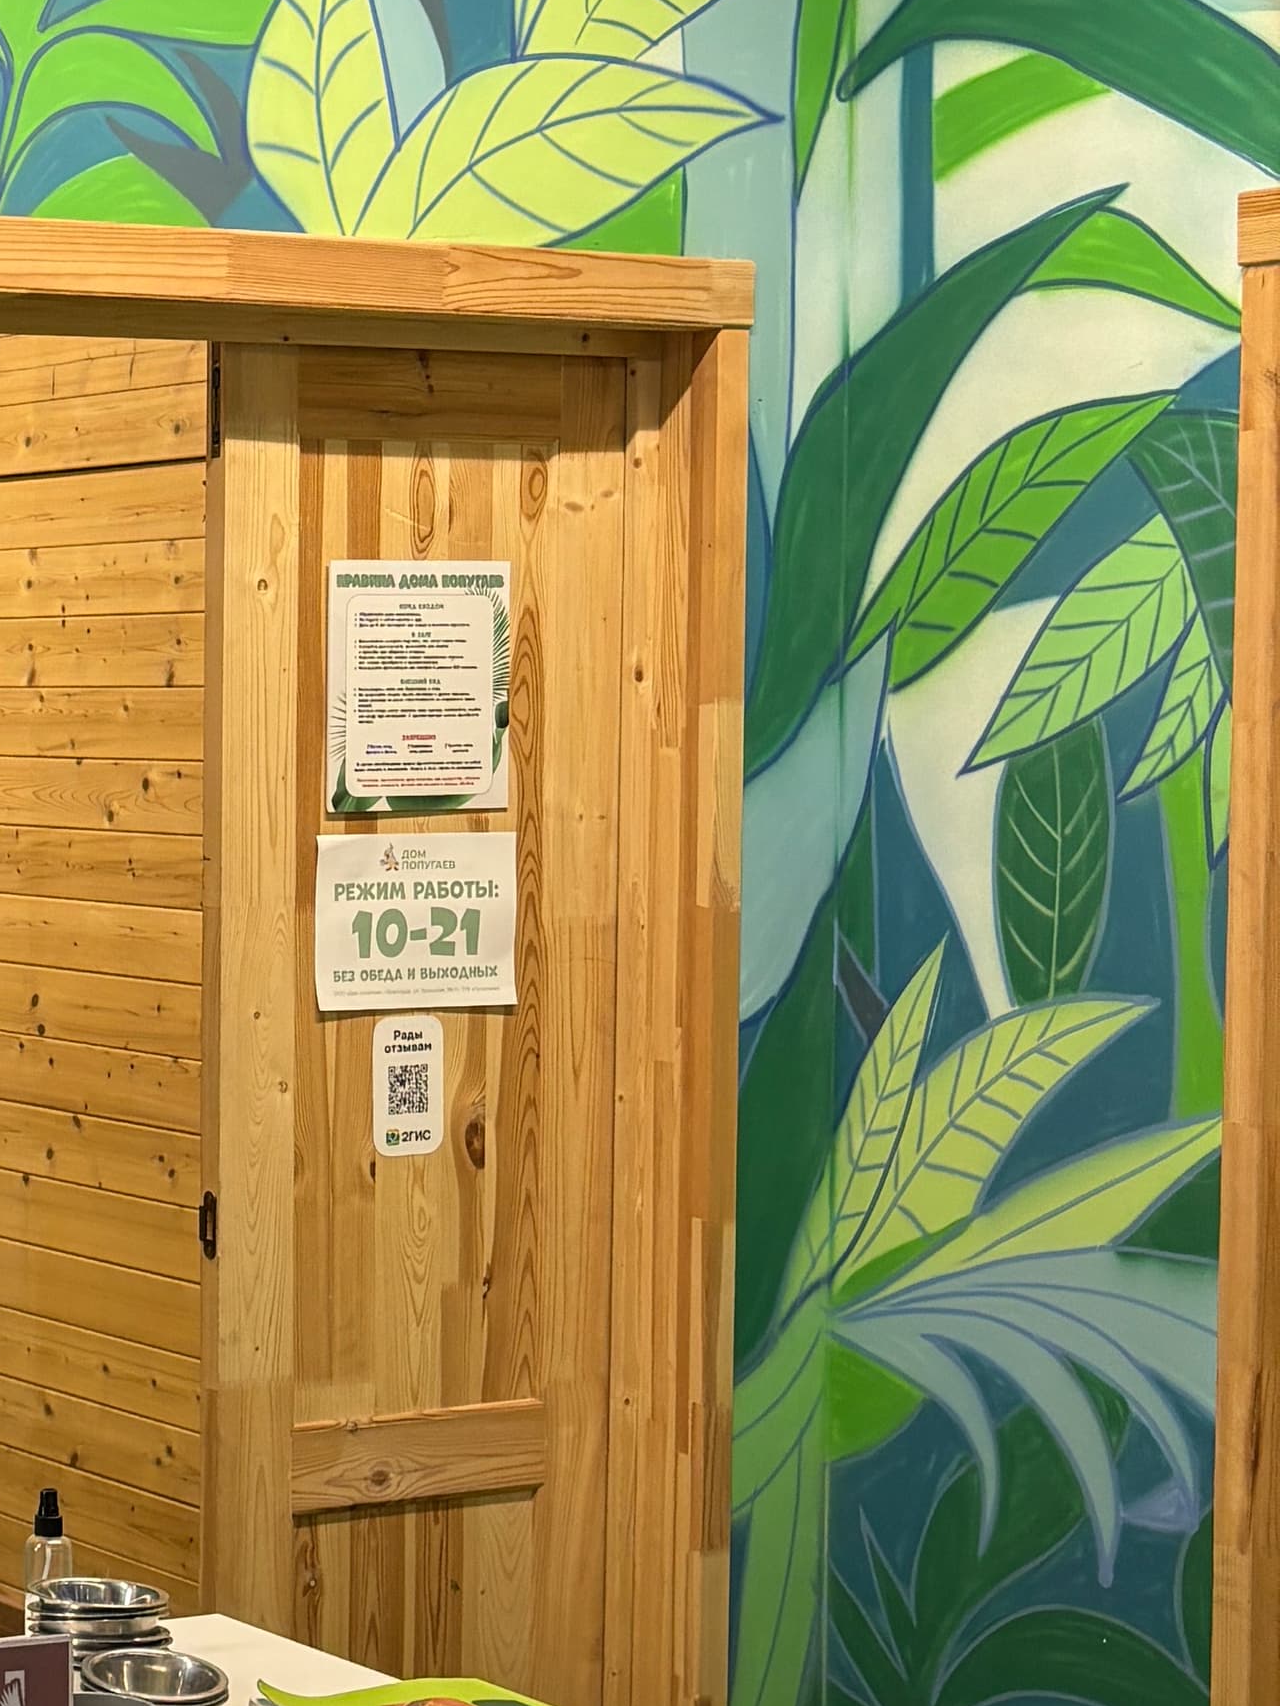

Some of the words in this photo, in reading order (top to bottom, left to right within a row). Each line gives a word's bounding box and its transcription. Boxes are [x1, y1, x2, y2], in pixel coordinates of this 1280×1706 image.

[401, 849, 426, 860] ДОМ
[402, 860, 456, 870] ПОПУГАЕВ
[334, 881, 406, 901] РЕЖИМ
[413, 880, 499, 900] РАБОТЫ:
[352, 906, 481, 959] 10-21
[333, 970, 355, 983] БЕЗ
[360, 968, 403, 982] ОБЕДА
[407, 968, 416, 980] И
[420, 965, 498, 980] ВЫХОДНЫХ
[393, 1030, 423, 1041] Рады
[384, 1043, 432, 1053] отзывам
[401, 1130, 432, 1142] 2ГИС
